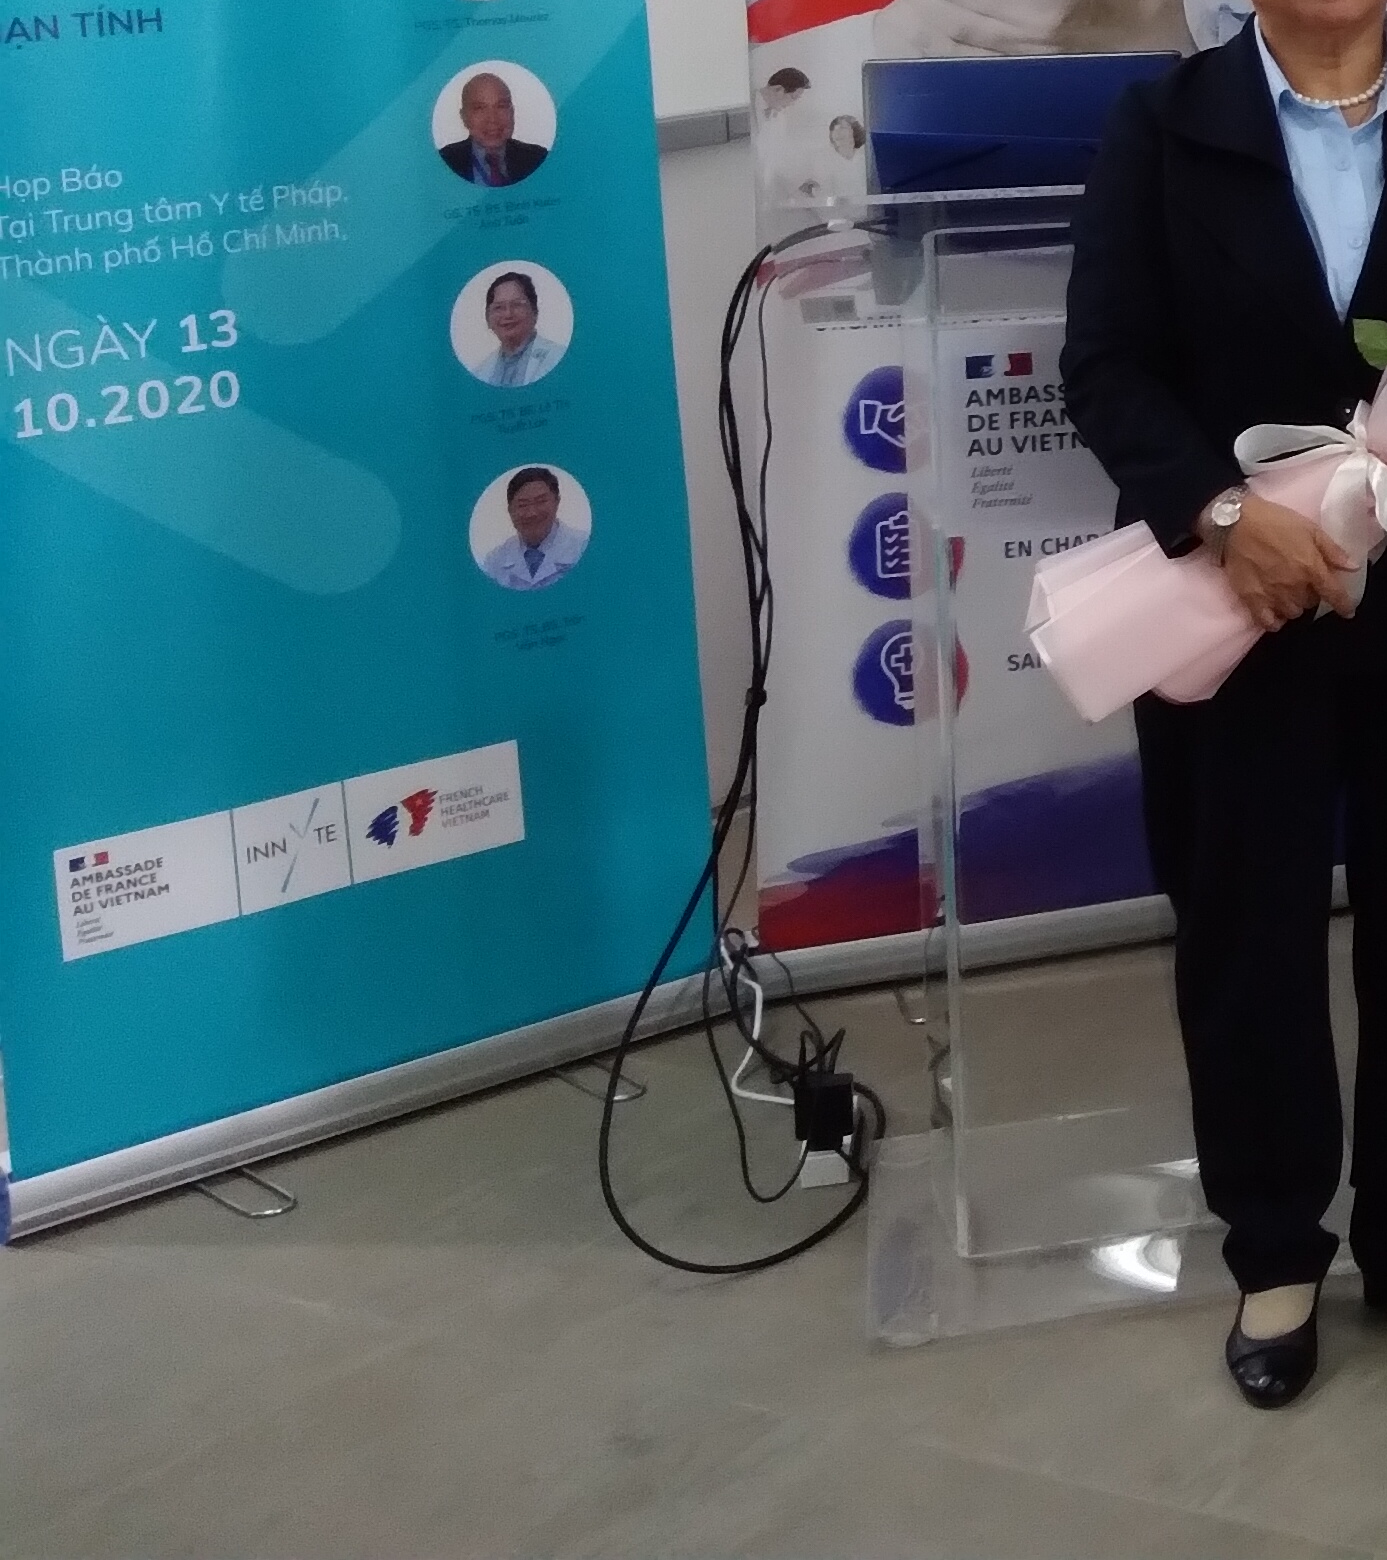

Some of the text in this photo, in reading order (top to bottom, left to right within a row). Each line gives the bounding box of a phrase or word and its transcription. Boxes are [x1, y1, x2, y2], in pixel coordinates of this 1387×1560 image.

[0, 4, 163, 50] ẠN TÍNH
[61, 163, 122, 193] Báo
[43, 208, 133, 233] Trung
[142, 197, 202, 224] tâm
[209, 192, 229, 216] Y
[238, 184, 265, 213] tế
[0, 247, 93, 280] Thành
[104, 235, 161, 274] phố
[171, 230, 213, 260] Hồ
[223, 223, 268, 254] Chí
[6, 309, 238, 376] NGÀY 13
[14, 370, 240, 439] 10.2020
[967, 413, 1000, 433] DE
[967, 437, 1003, 457] AU
[971, 465, 1013, 478] Liberté
[972, 494, 1033, 509] Fraternité
[1004, 540, 1032, 559] EN
[439, 785, 483, 804] FRENCH
[441, 791, 509, 816] HEALTHCARE
[70, 857, 163, 889] AMBASSADE
[71, 872, 157, 903] DE FRANCE
[73, 883, 170, 917] AU VIETNAM
